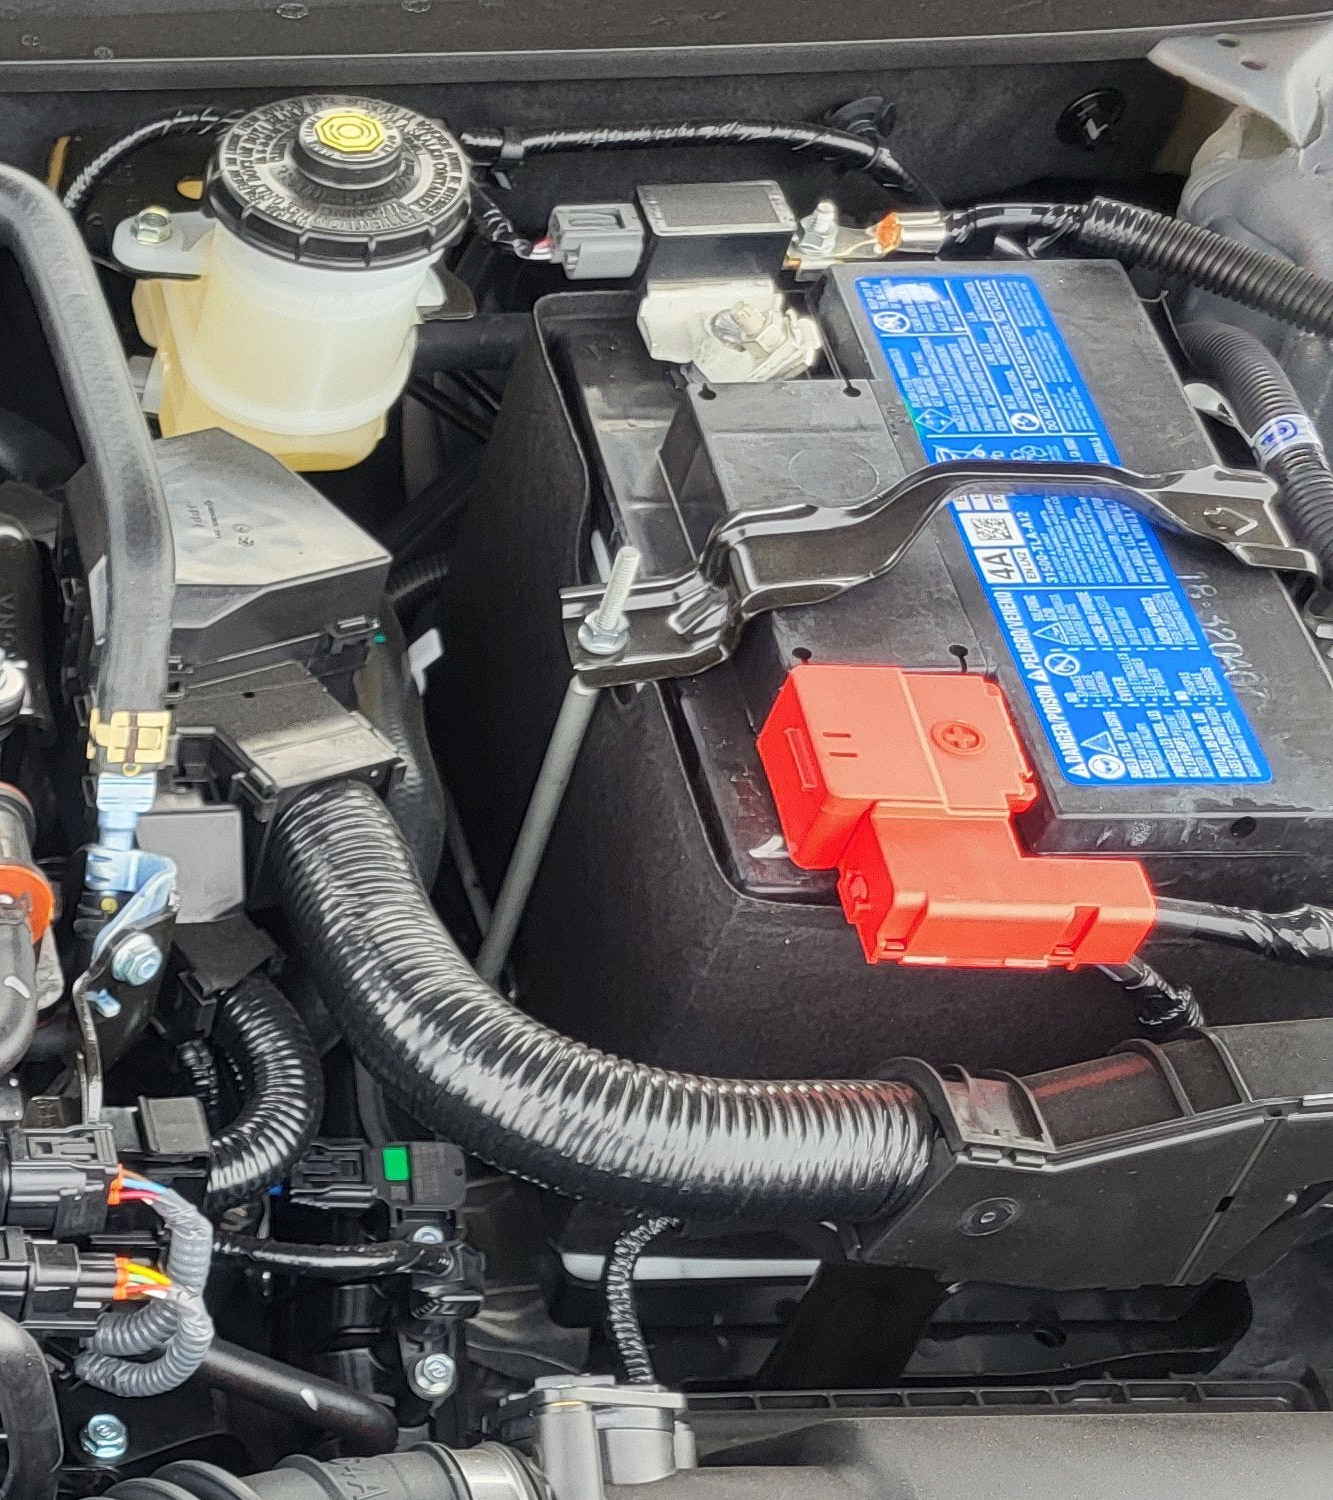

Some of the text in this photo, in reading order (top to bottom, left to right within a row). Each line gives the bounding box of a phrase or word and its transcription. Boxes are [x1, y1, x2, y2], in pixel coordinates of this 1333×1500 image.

[1037, 404, 1053, 418] NOT
[978, 552, 1018, 579] 4A
[1015, 511, 1059, 582] 31500-TLA-A12
[1015, 551, 1031, 566] LN2
[991, 591, 1045, 669] PELIGRO/VENENO
[1032, 684, 1085, 762] DANGER/POISON
